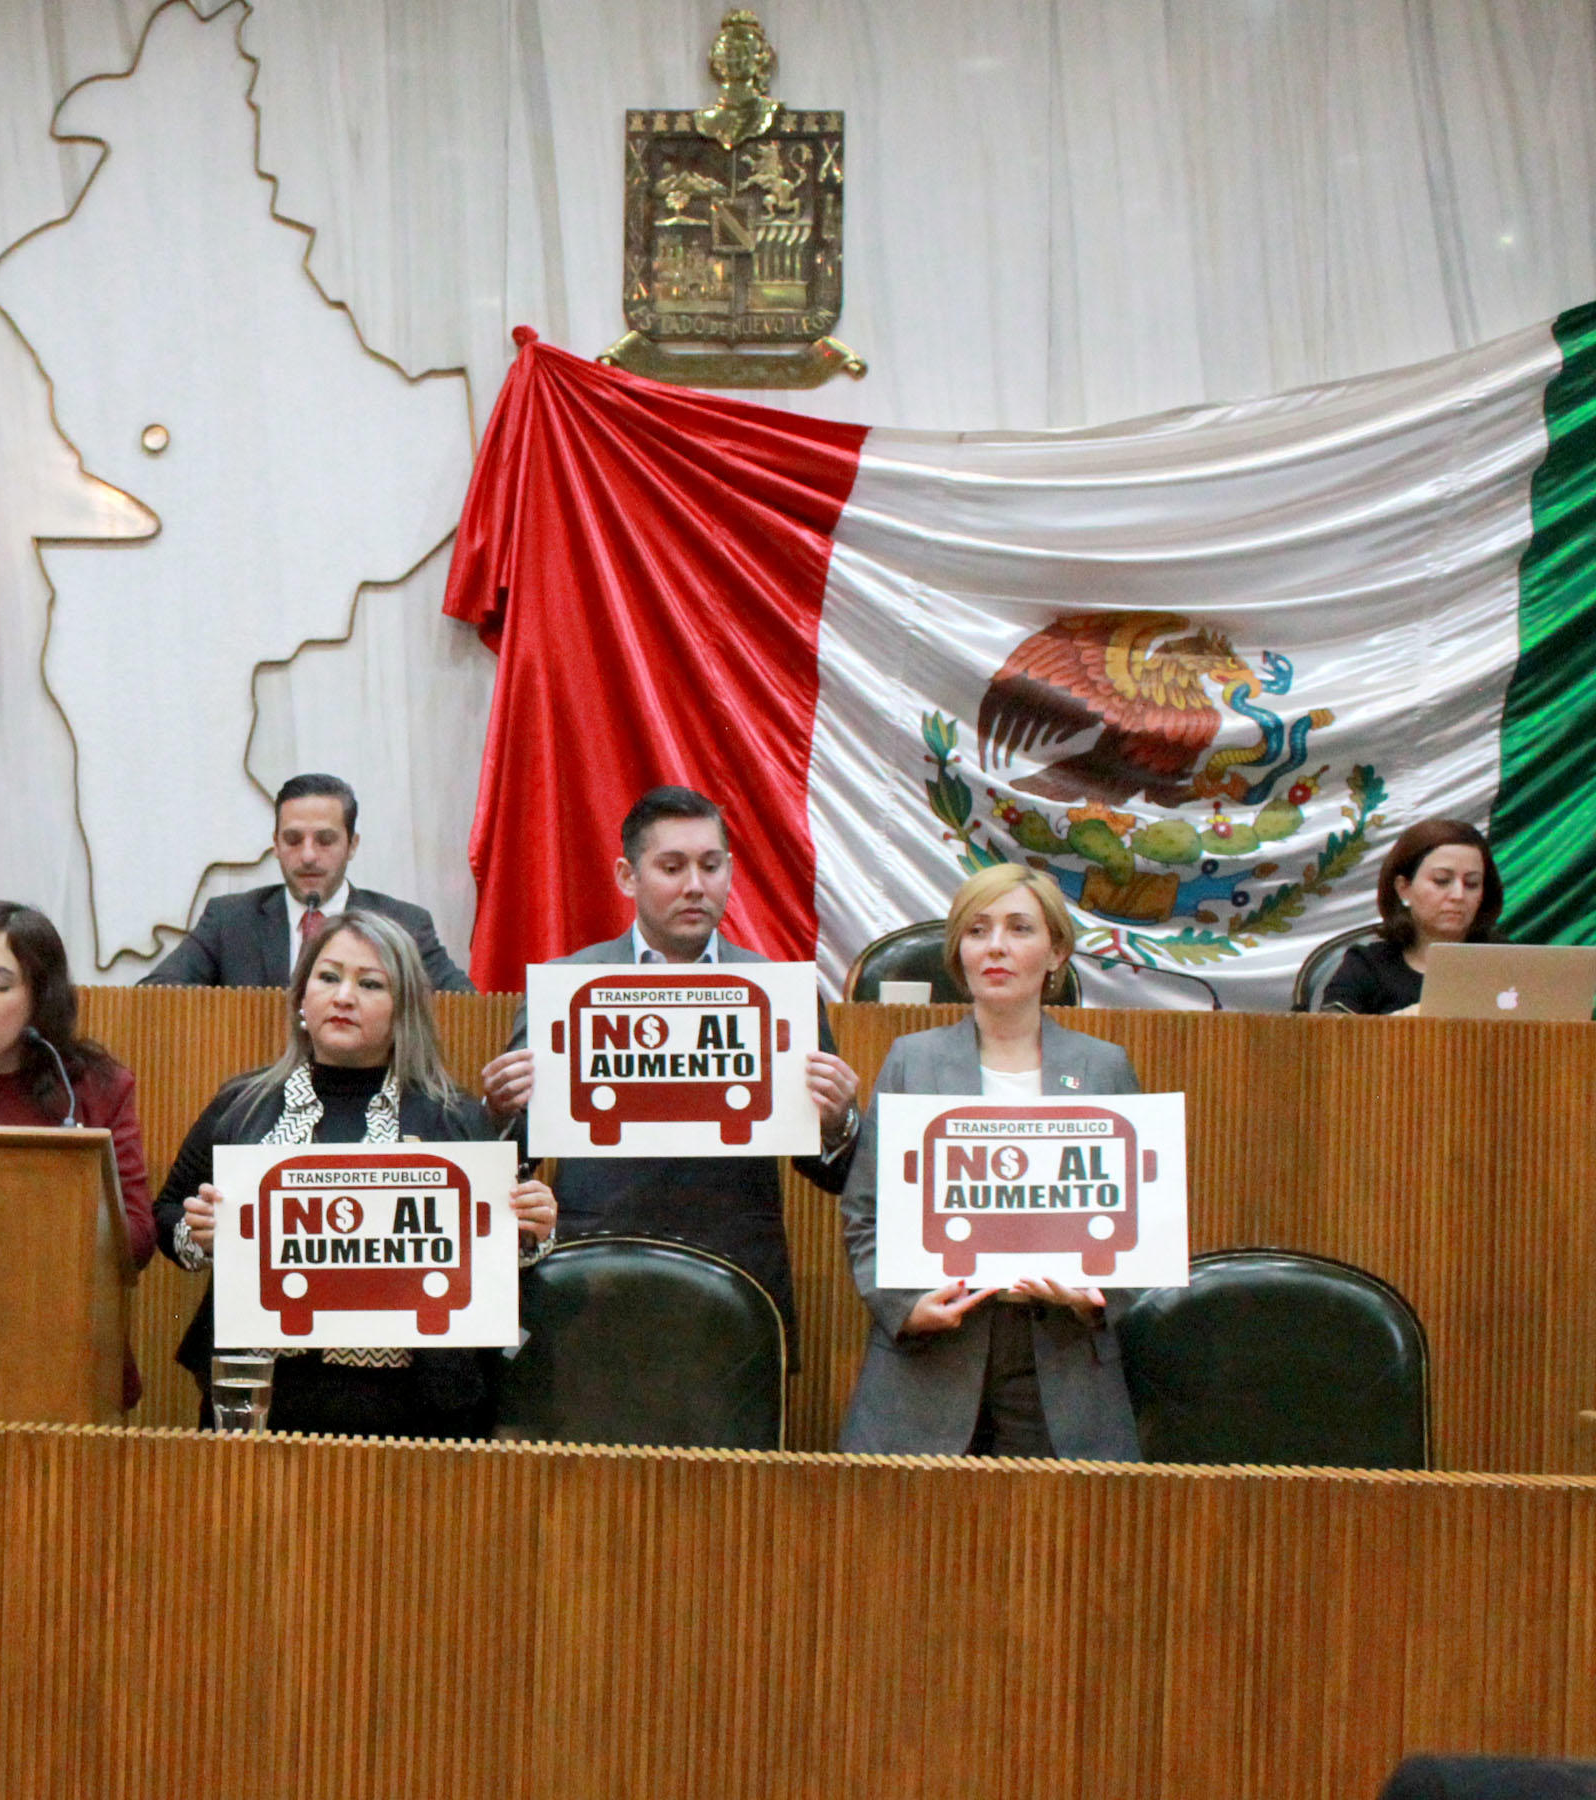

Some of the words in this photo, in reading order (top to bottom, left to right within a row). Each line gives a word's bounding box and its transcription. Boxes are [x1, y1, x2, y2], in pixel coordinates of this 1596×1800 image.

[597, 990, 682, 1002] TRANSPORTE
[687, 990, 743, 1001] PUBLICO
[697, 1014, 745, 1050] AL
[590, 1053, 754, 1078] AUMENTO
[953, 1122, 1043, 1134] TRANSPORTE
[1048, 1121, 1108, 1133] PUBLICO
[1058, 1145, 1109, 1181] AL
[288, 1171, 377, 1184] TRANSPORTE
[382, 1170, 442, 1183] PUBLICO
[944, 1183, 1120, 1209] AUMENTO
[393, 1196, 443, 1234] AL
[280, 1236, 453, 1264] AUMENTO
